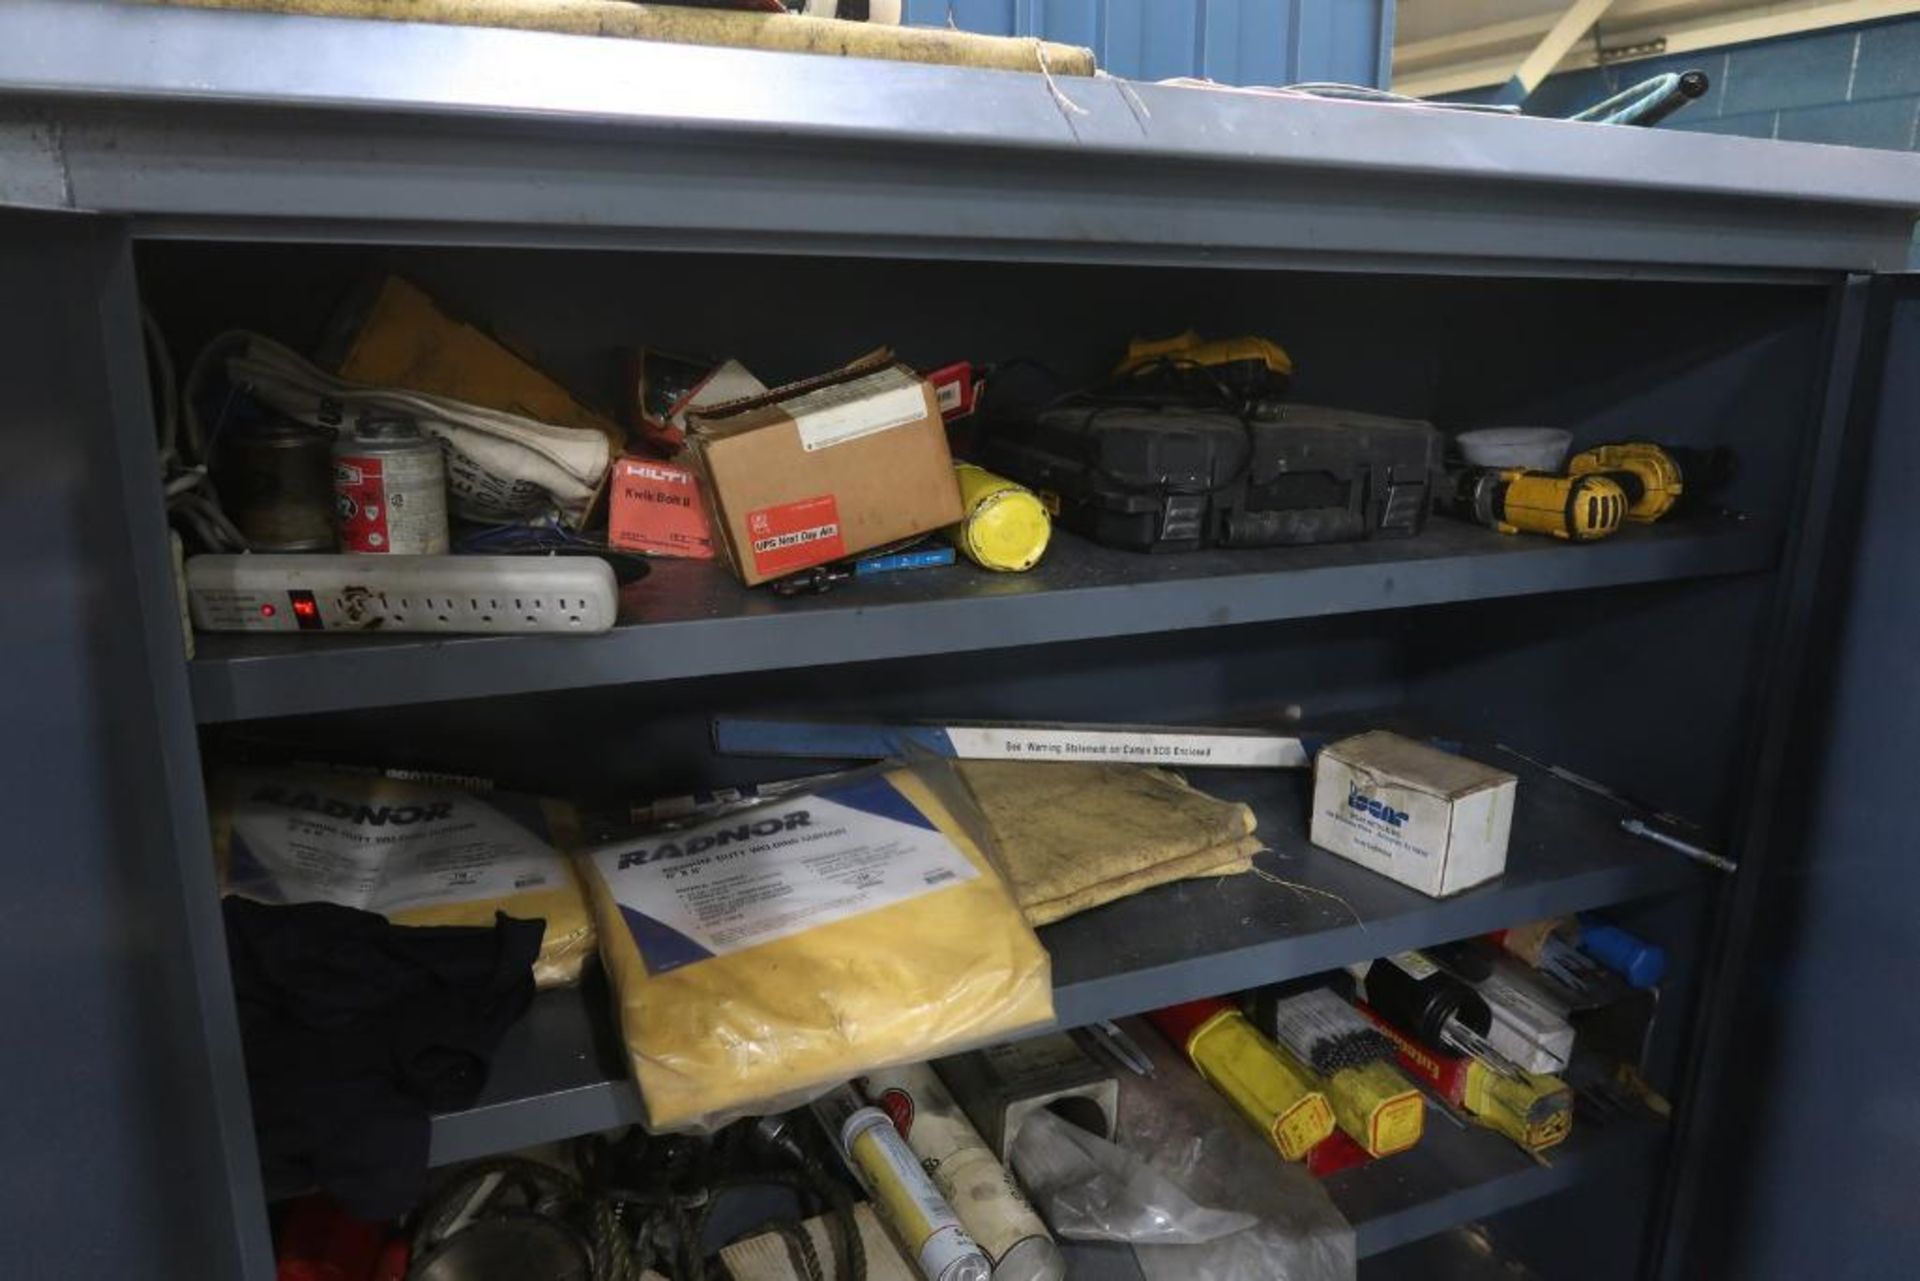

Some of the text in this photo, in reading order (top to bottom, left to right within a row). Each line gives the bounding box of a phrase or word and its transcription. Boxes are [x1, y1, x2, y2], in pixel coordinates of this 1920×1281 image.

[627, 465, 689, 485] HILTI
[624, 487, 654, 503] Kwik
[656, 491, 681, 506] Bolt
[755, 539, 777, 552] UPS
[1005, 742, 1021, 753] See
[1026, 742, 1061, 755] Warning
[1065, 742, 1106, 754] Statement
[1109, 745, 1120, 754] on
[1122, 744, 1151, 755] Carton
[1174, 745, 1211, 756] Enclosed
[251, 783, 454, 827] RADNOR
[617, 808, 813, 871] RADNOR
